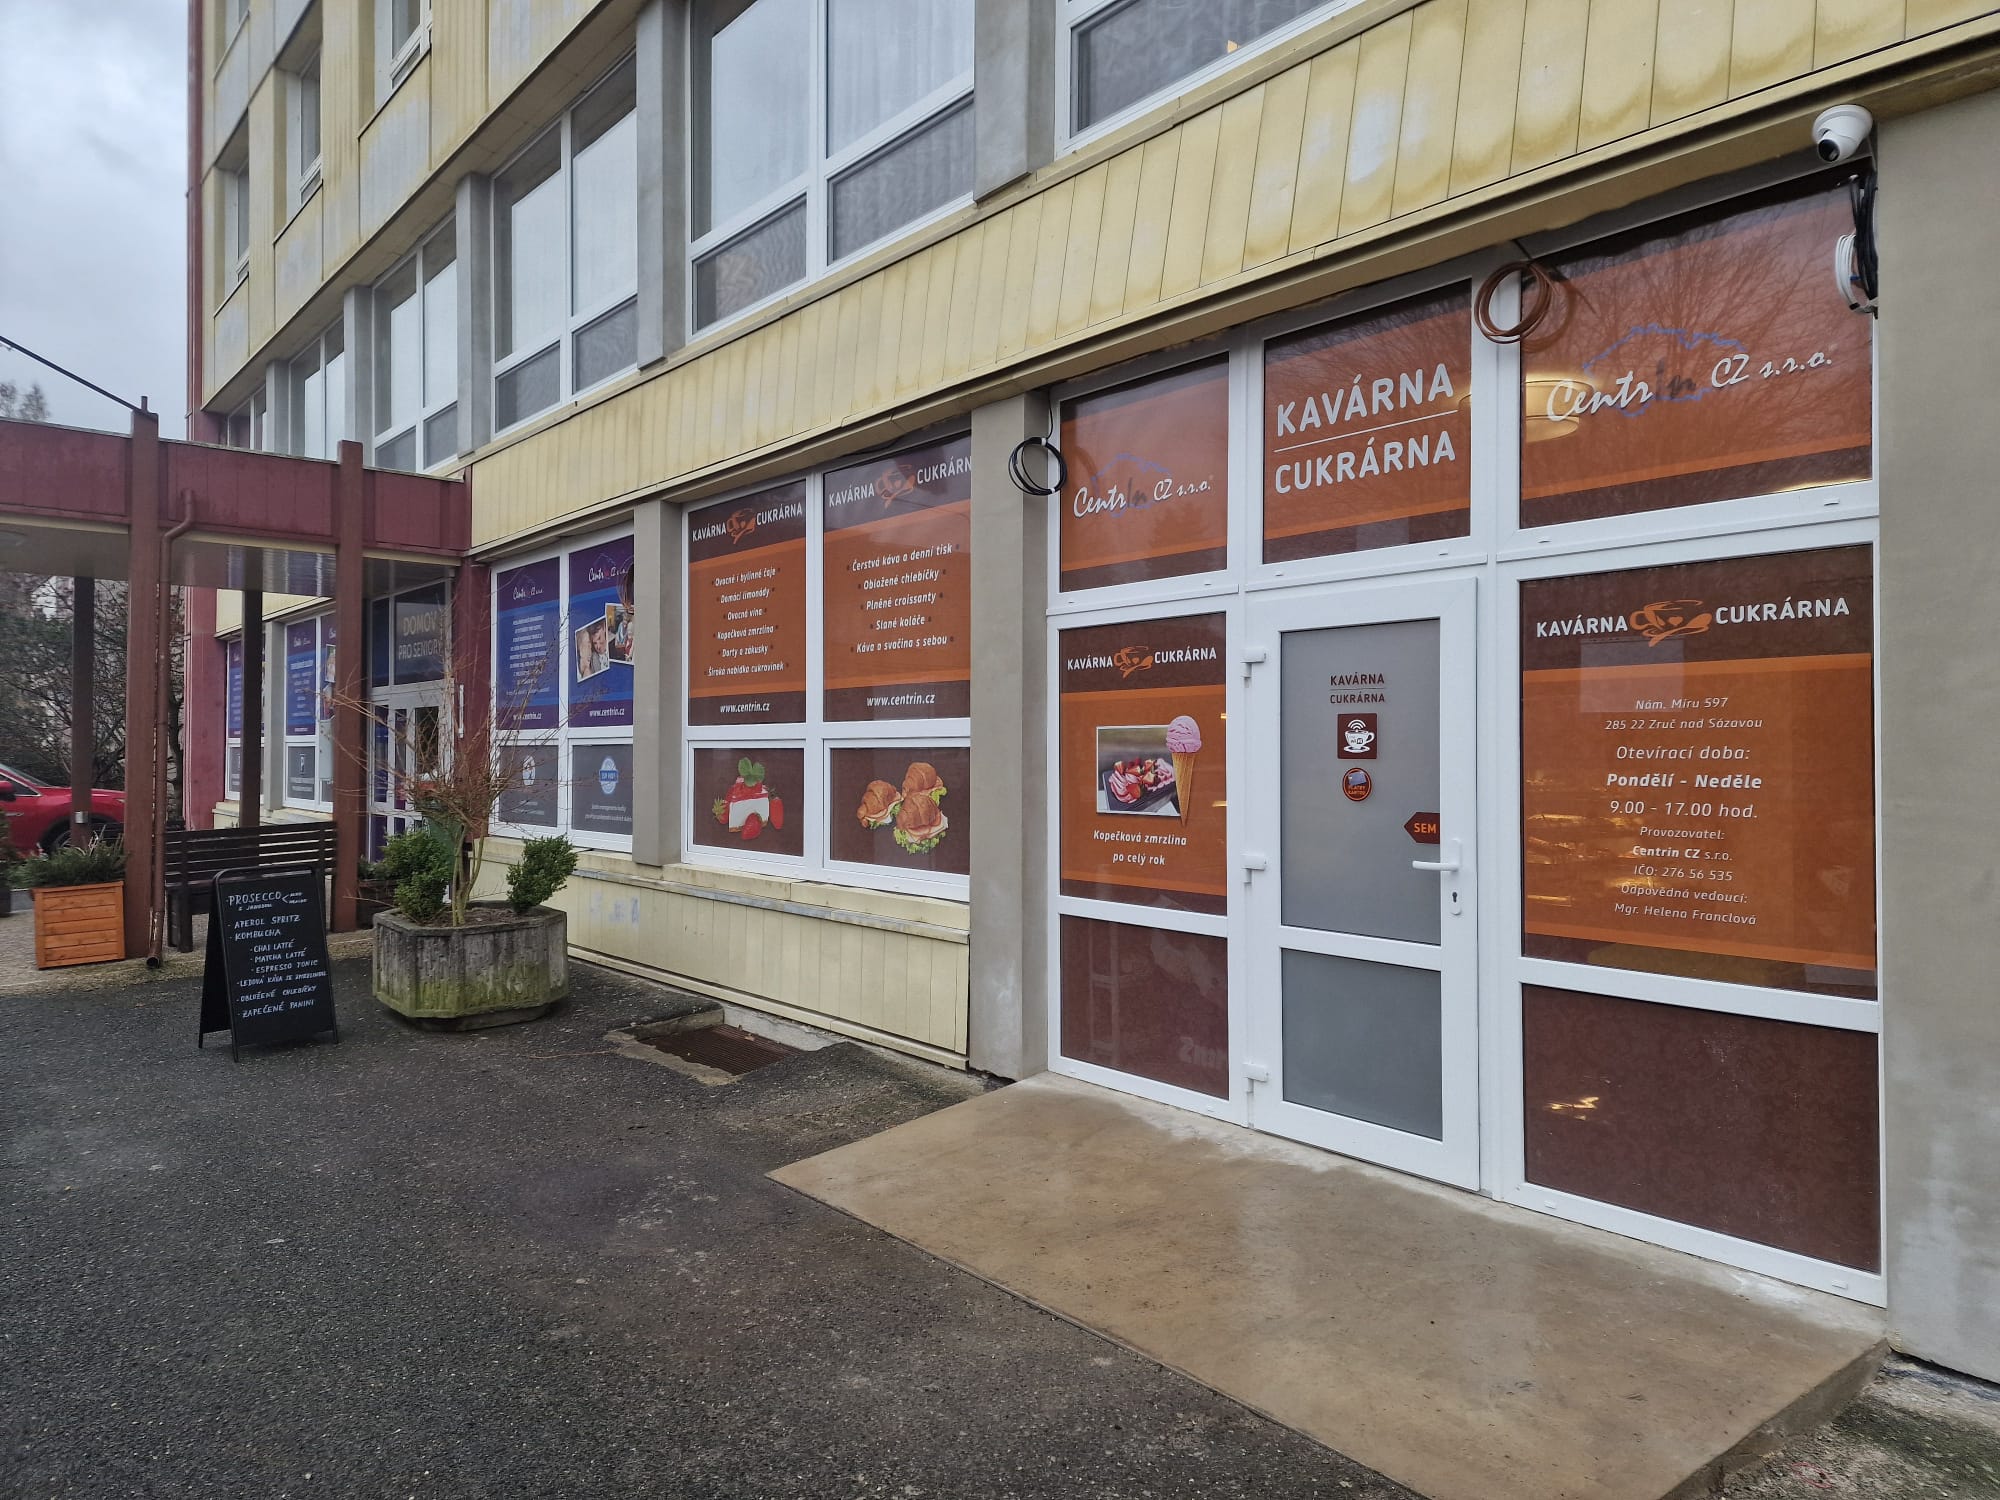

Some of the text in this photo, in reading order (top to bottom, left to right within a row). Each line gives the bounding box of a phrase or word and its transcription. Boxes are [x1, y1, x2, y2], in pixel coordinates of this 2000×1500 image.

[1711, 353, 1750, 388] CZ
[1759, 351, 1833, 380] s.r.o.
[1277, 363, 1454, 437] KAVÁRNA
[1275, 430, 1456, 494] CUKRÁRNA
[828, 455, 972, 508] KAVÁRNA CUKRÁRN
[1154, 478, 1173, 501] CZ
[1177, 480, 1211, 497] s.r.o.
[692, 502, 803, 542] KAVÁRNA CUKRÁRNA
[852, 543, 953, 571] Čerstvá káva a denní tisk
[863, 569, 940, 590] Obložené chlebíčky
[866, 592, 937, 610] Plněné croissanty
[876, 614, 925, 630] Slané koláče
[1536, 597, 1850, 638] KAVÁRNA CUKRÁRNA
[856, 635, 948, 653] Káva a svačina s sebou
[1067, 646, 1217, 671] KAVÁRNA CUKRÁRNA
[1330, 672, 1385, 686] KAVÁRNA
[866, 692, 936, 707] www.centrin.cz
[1330, 691, 1385, 704] CUKRÁRNA
[1635, 699, 1667, 710] Nám.
[1704, 697, 1728, 708] 597
[720, 701, 770, 713] www.centrin.cz
[1604, 717, 1763, 730] 285 22 Zruč nad Sázavou
[1616, 745, 1751, 760] Otevírací doba:
[1606, 773, 1675, 788] Pondělí
[1695, 774, 1762, 789] Neděle
[1610, 801, 1645, 815] 9.00
[1664, 802, 1712, 818] 17.00
[1718, 803, 1758, 819] hod.
[1414, 823, 1437, 834] SEM
[1640, 826, 1725, 840] Provozovatel:
[1093, 830, 1187, 846] Kopečková zmrzlina
[1113, 852, 1166, 866] po celý rok
[1633, 845, 1733, 861] Centrin CZ s.r.o.
[1634, 864, 1733, 881] IČO: 276 56 535
[228, 891, 282, 906] PROSECCO
[1621, 884, 1748, 904] Odpovědná vedoucí:
[234, 914, 301, 929] APEROL SPRITZ
[1614, 903, 1757, 925] Mgr. Helena Franclová
[235, 929, 281, 941] KOMBUCHA
[253, 943, 271, 953] CHAI
[254, 953, 282, 963] MATCHA
[255, 959, 318, 974] ESPRESSO TONIC
[242, 999, 314, 1018] ZAPEČENÉ PANINI
